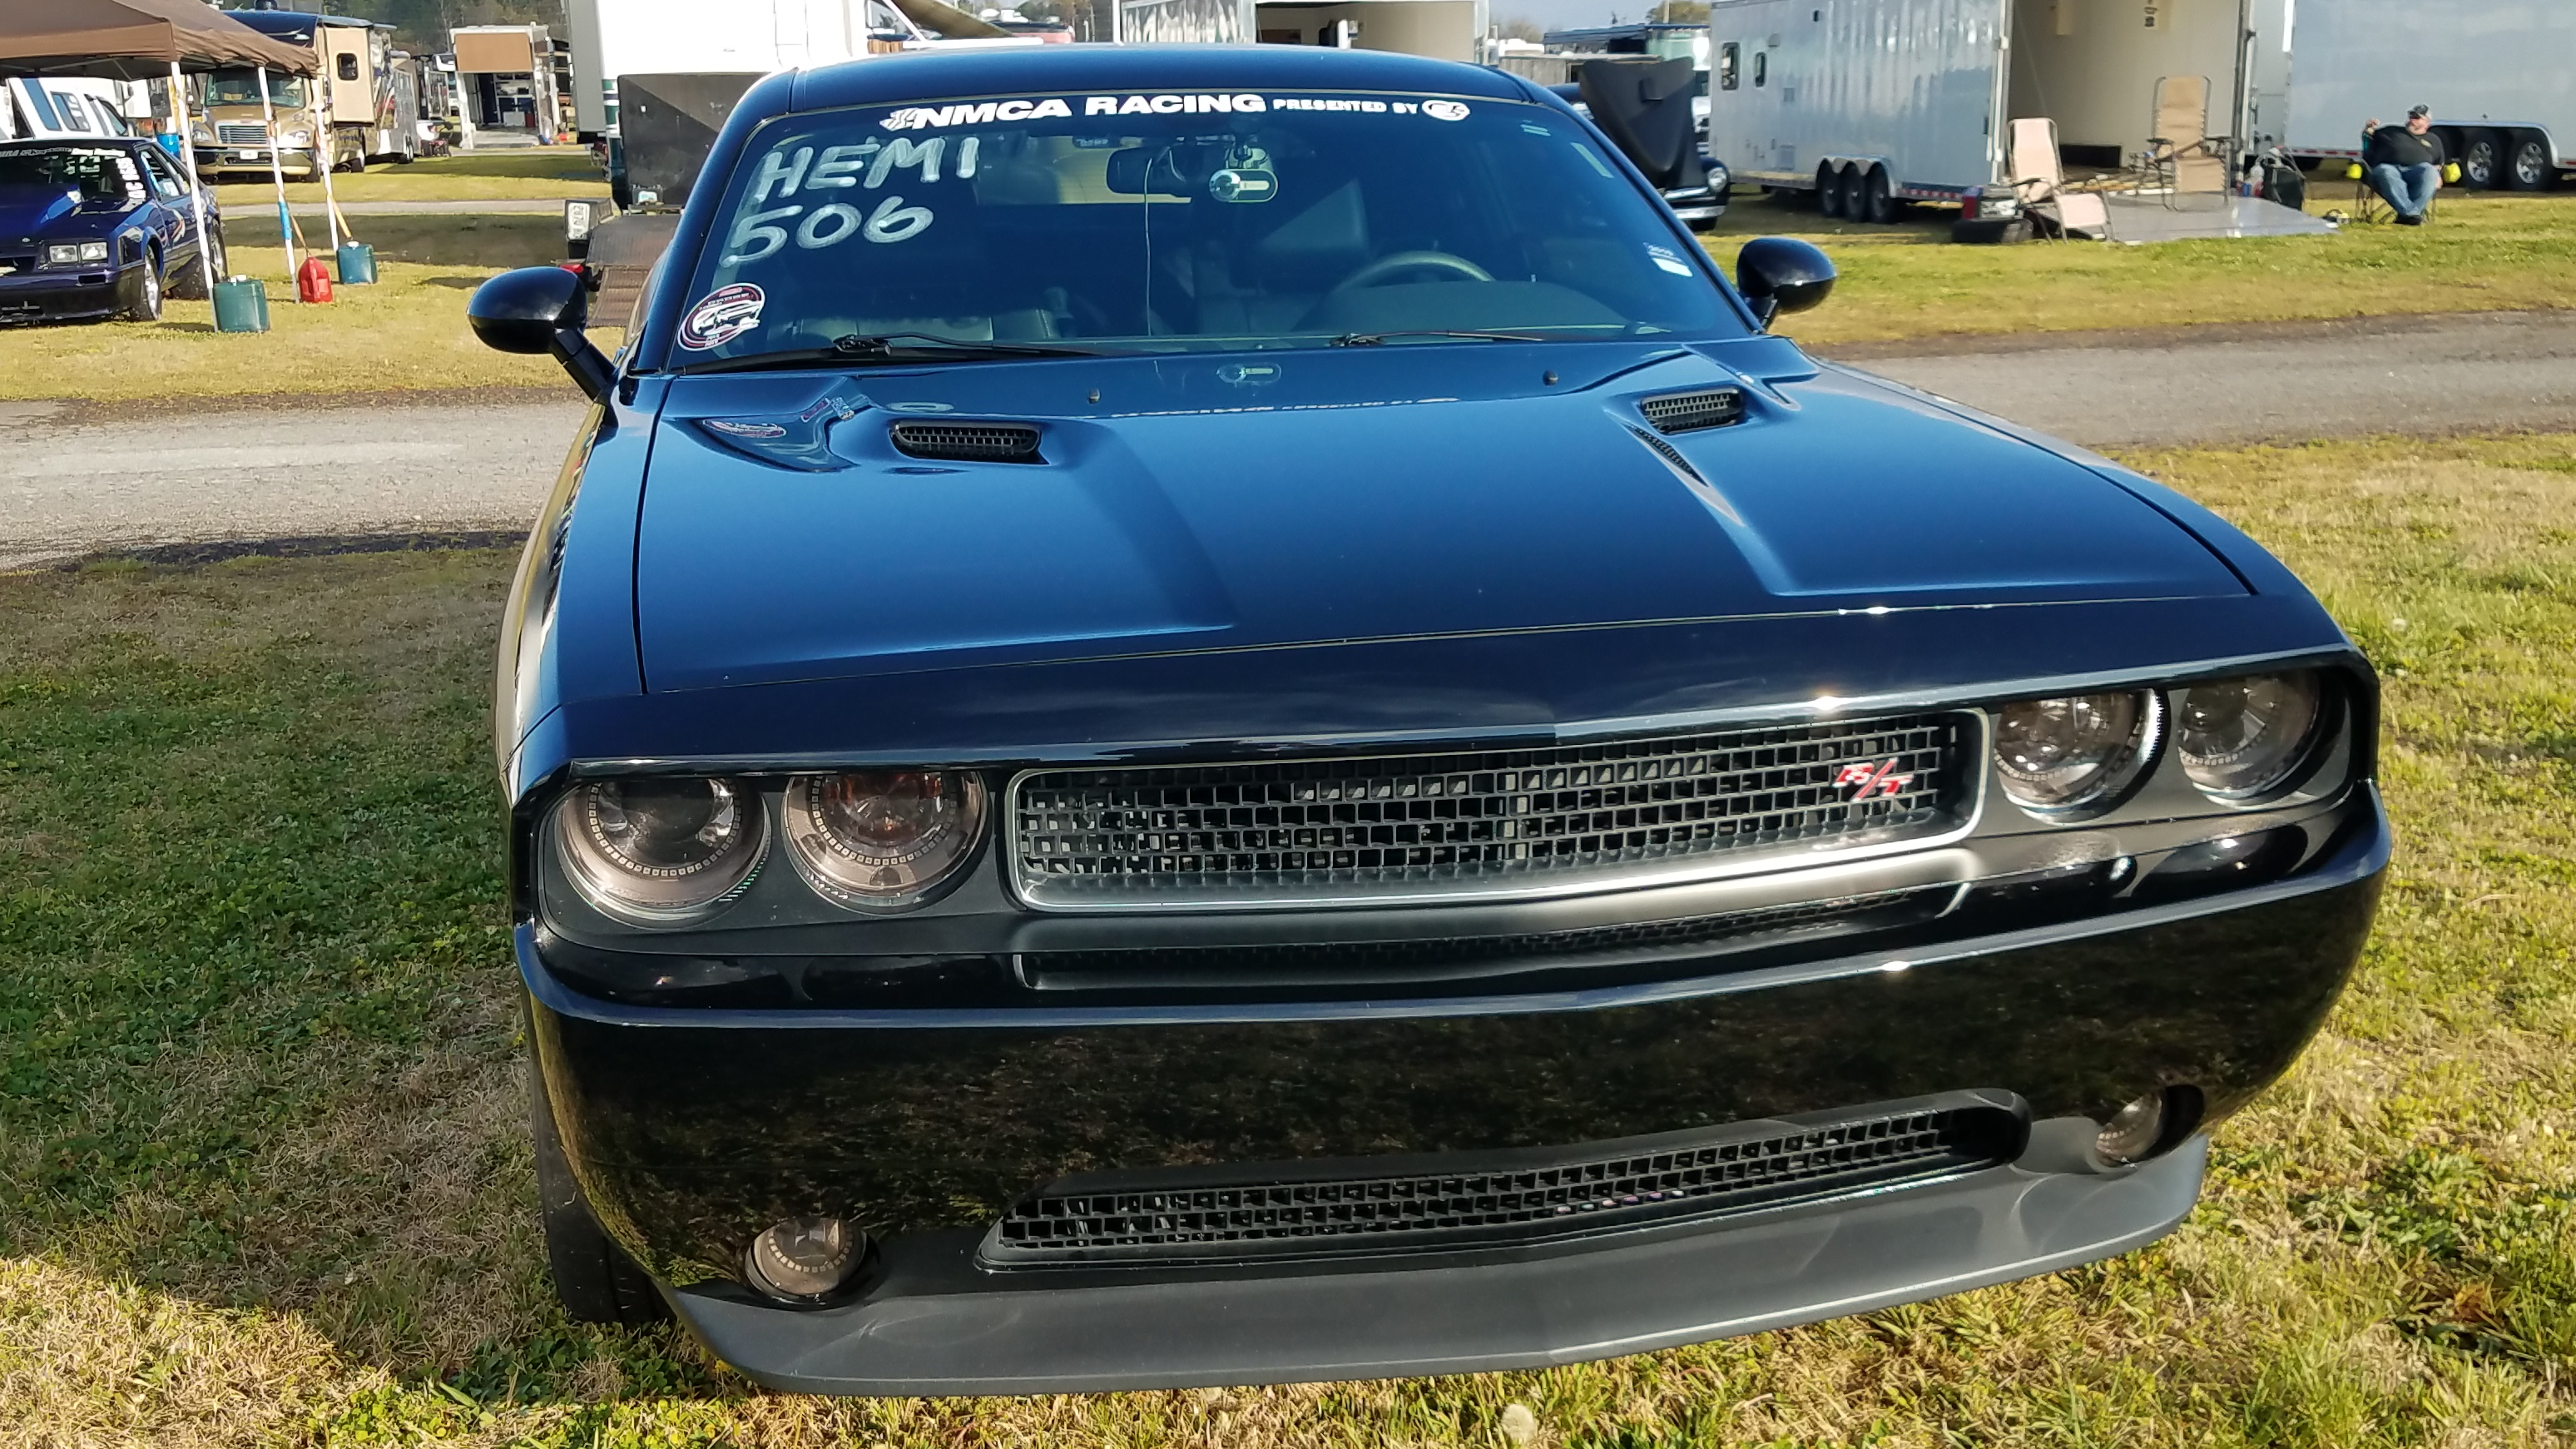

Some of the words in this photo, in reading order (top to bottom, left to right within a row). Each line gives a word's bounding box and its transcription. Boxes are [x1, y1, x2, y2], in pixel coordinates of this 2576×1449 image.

[912, 98, 1073, 130] NMCA
[1084, 93, 1267, 116] RACING
[1272, 98, 1387, 112] PRESENTED
[1391, 102, 1419, 114] BY
[754, 136, 980, 203] HEMI
[719, 195, 934, 267] 506
[1832, 757, 1914, 804] R/T
